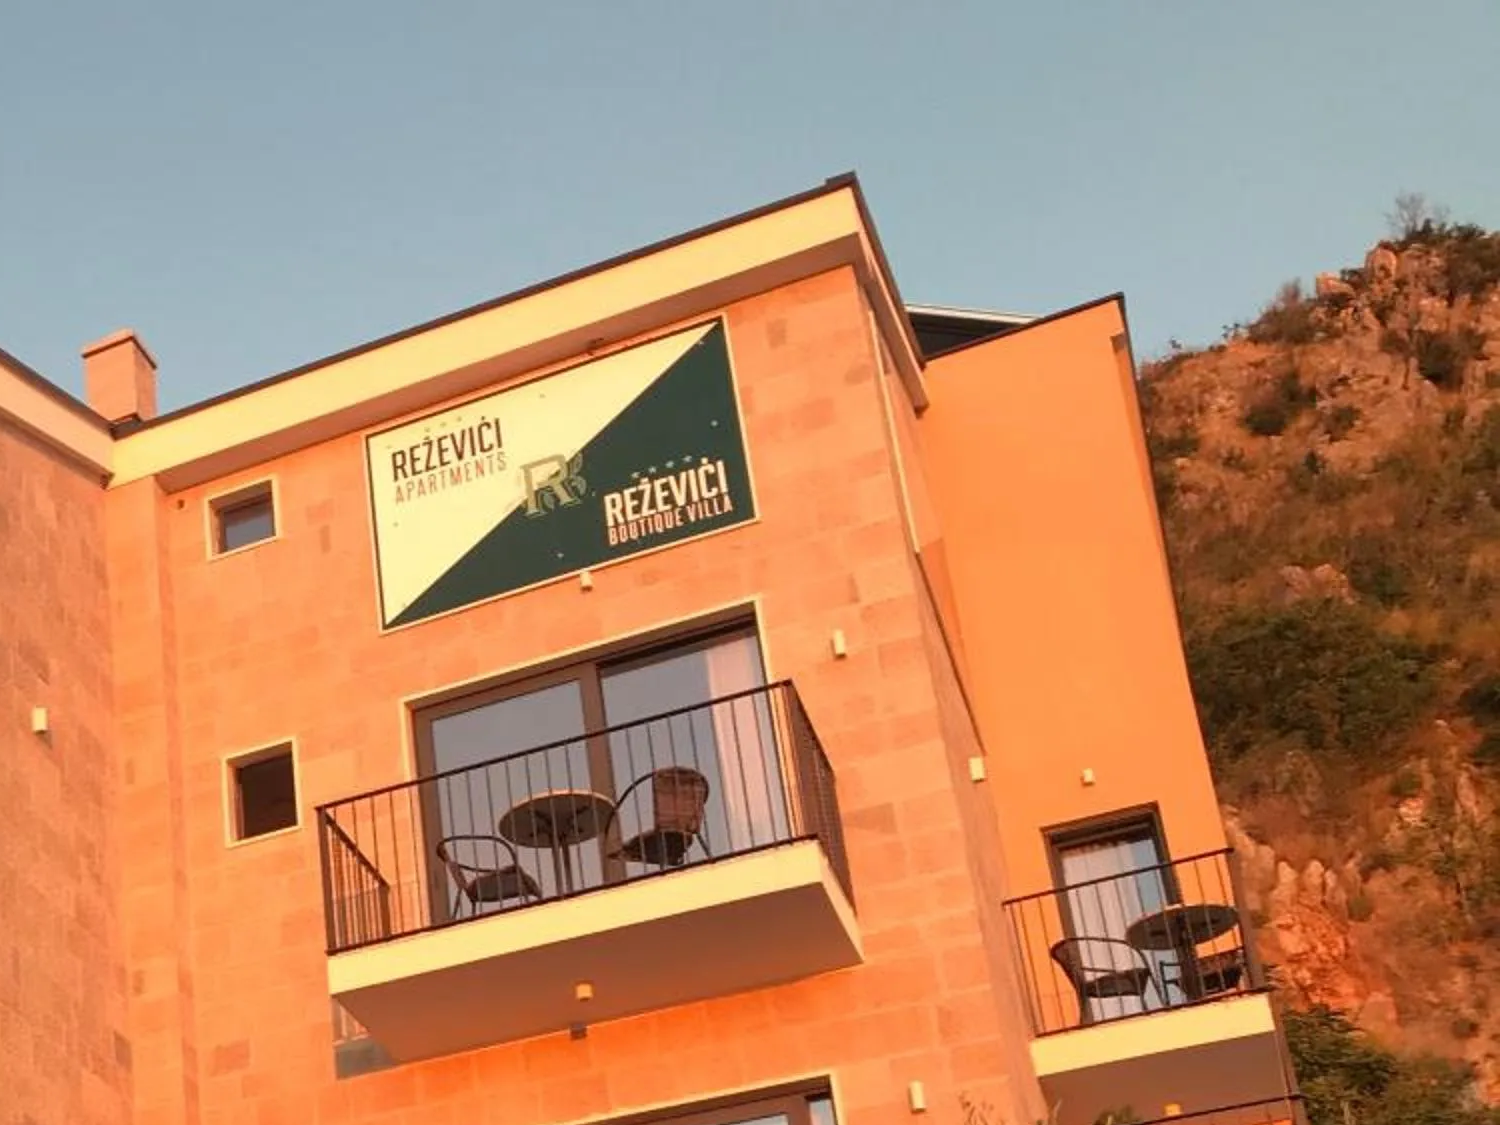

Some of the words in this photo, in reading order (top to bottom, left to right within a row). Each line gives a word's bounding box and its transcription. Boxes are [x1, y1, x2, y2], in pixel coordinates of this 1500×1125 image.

[395, 451, 507, 505] APARTMENTS
[608, 507, 684, 546] BOUTIQUE
[687, 494, 734, 523] VILLA
